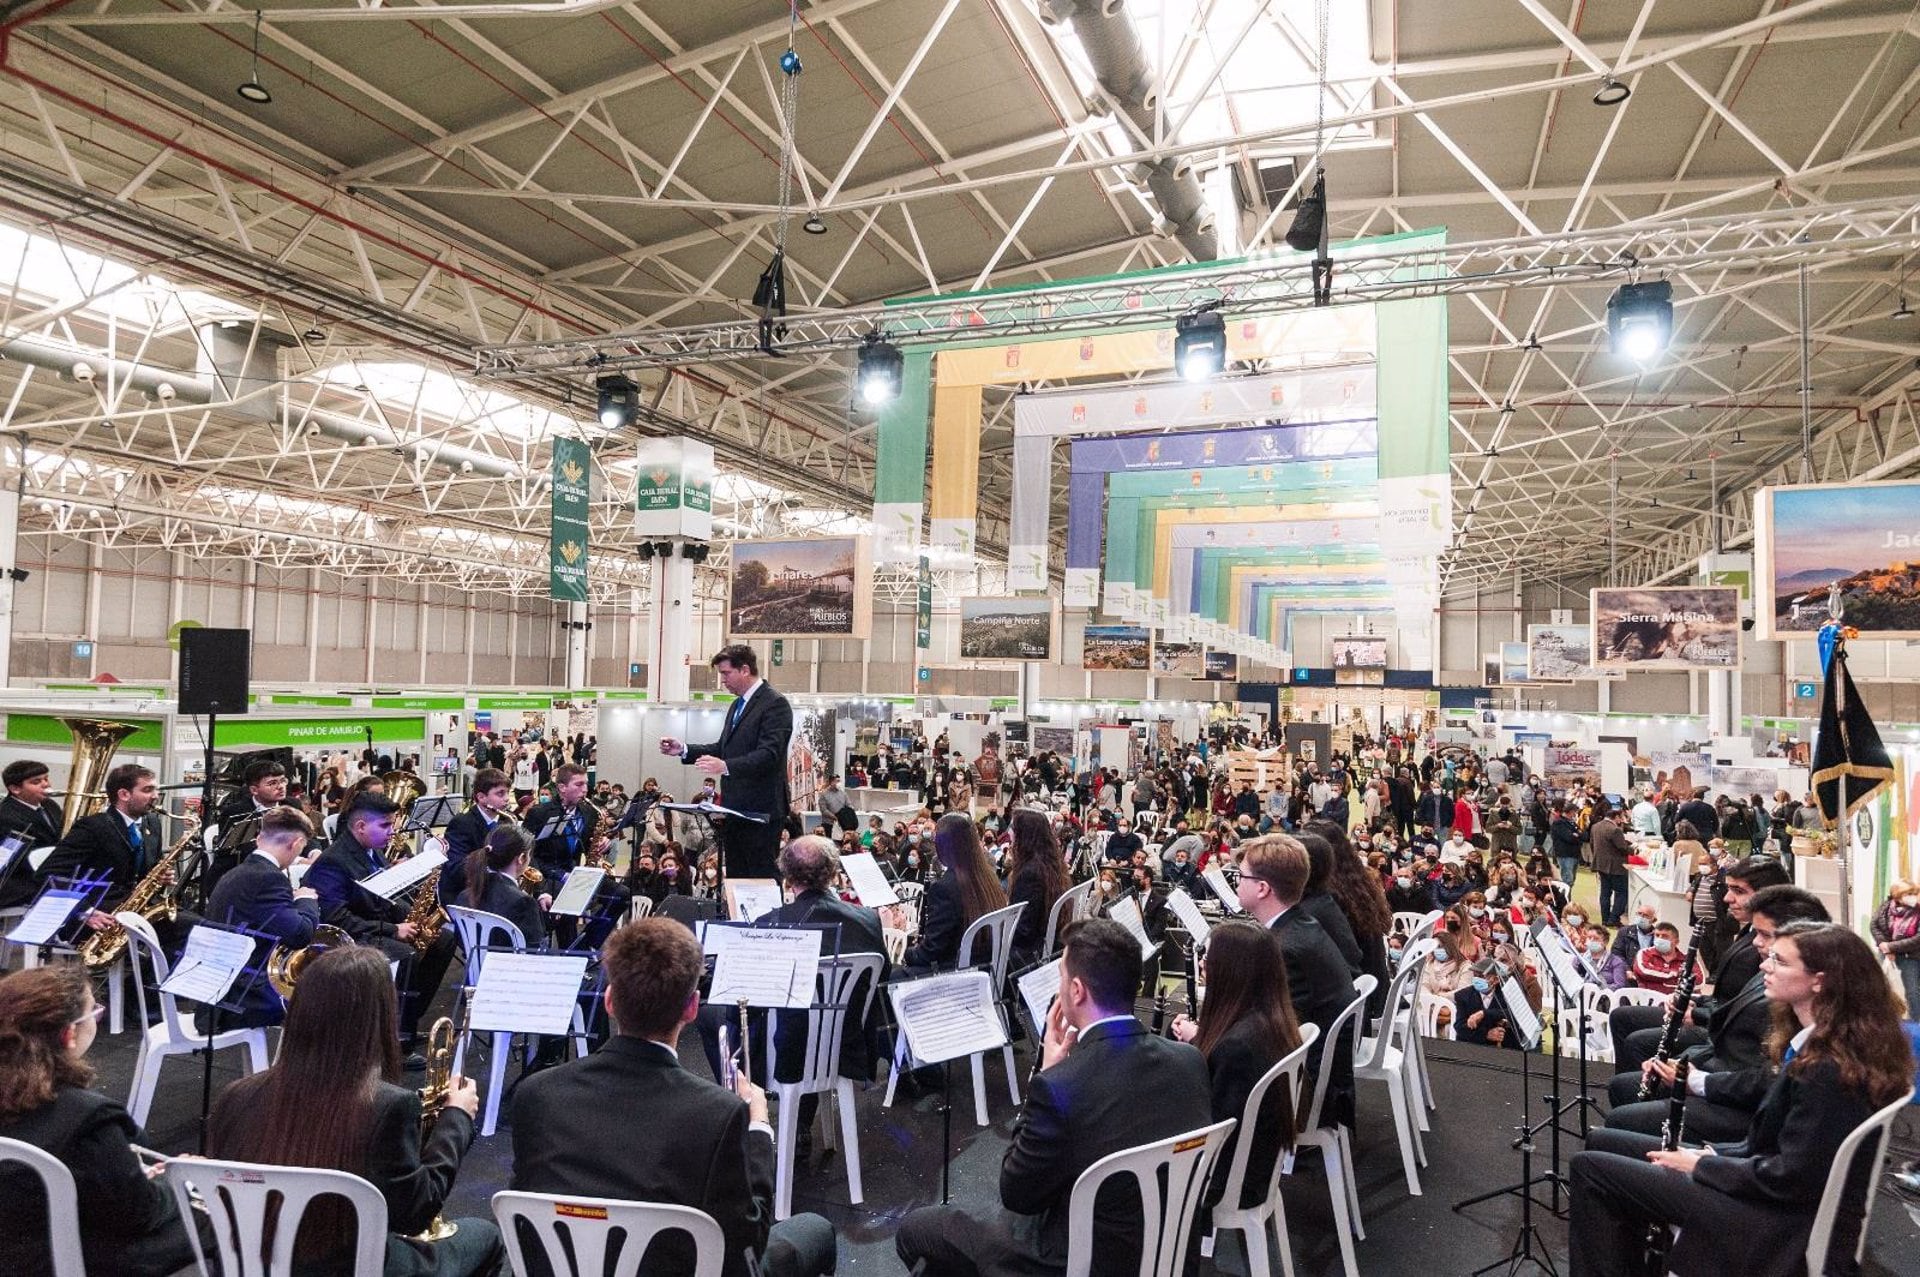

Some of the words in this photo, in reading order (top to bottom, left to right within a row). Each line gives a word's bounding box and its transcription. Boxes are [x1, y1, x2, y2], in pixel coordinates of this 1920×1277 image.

[640, 488, 656, 496] CAJA
[657, 487, 679, 495] RURAL
[973, 615, 1013, 626] Campiña
[1016, 616, 1041, 625] Norte
[1620, 612, 1659, 623] Sierra
[1662, 611, 1715, 625] Mágina
[77, 645, 91, 655] 10
[921, 670, 928, 679] 6
[1299, 669, 1306, 680] 4
[1802, 685, 1813, 697] 2
[288, 726, 314, 737] PINAR
[316, 726, 328, 736] DE
[329, 725, 363, 736] AMURJO
[1556, 750, 1591, 763] Jódar
